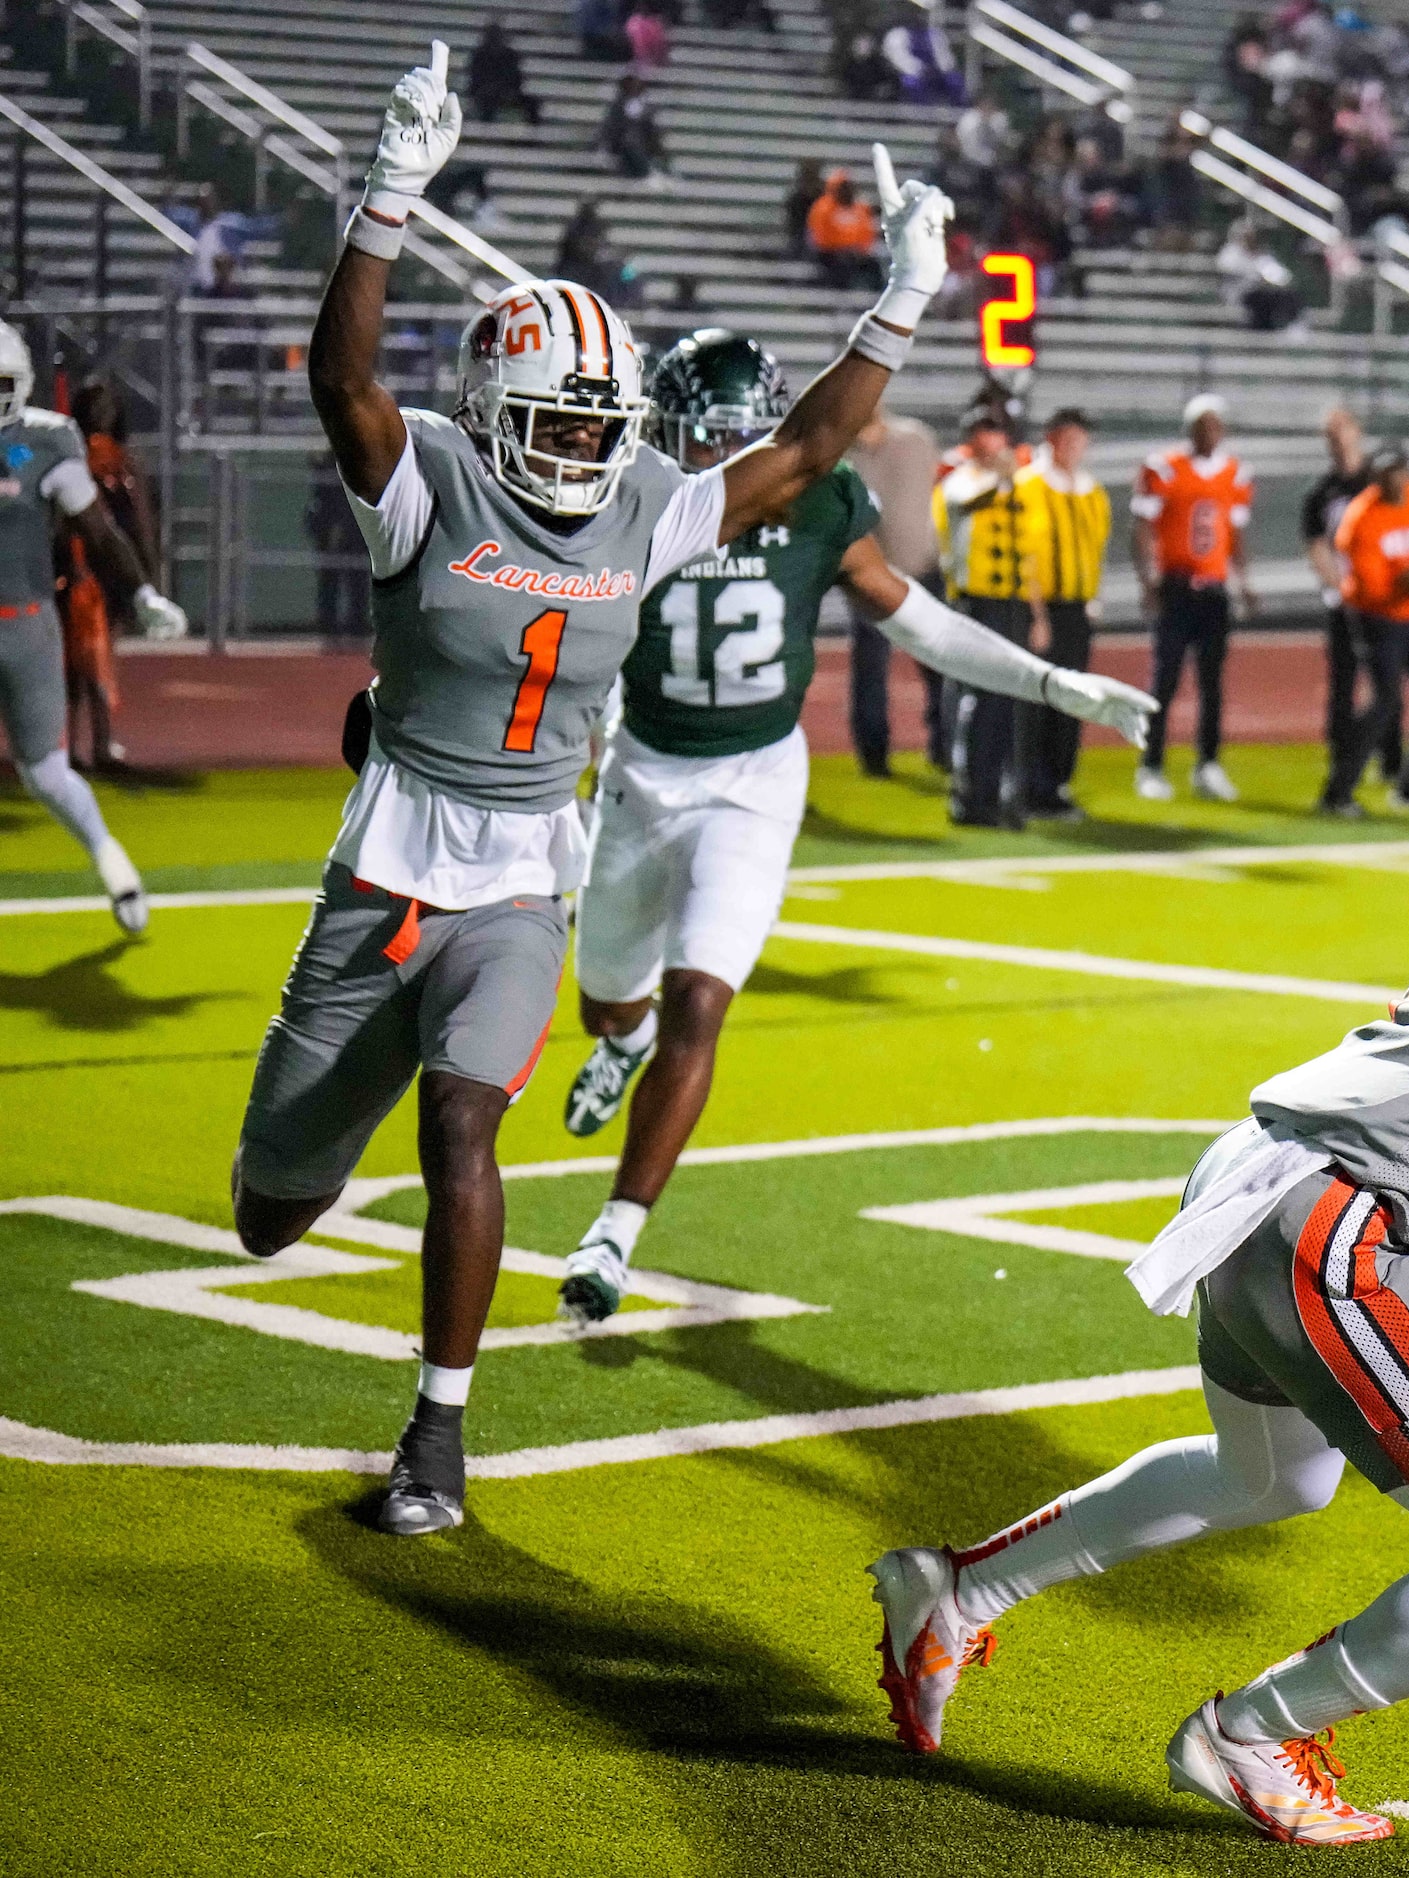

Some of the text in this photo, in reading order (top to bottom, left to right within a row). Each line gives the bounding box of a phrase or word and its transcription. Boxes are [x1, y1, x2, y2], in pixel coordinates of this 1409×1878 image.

[980, 252, 1037, 369] 2
[448, 539, 636, 602] Lancaster
[681, 556, 767, 579] INDIANS
[501, 607, 569, 753] 1
[660, 579, 788, 708] 12
